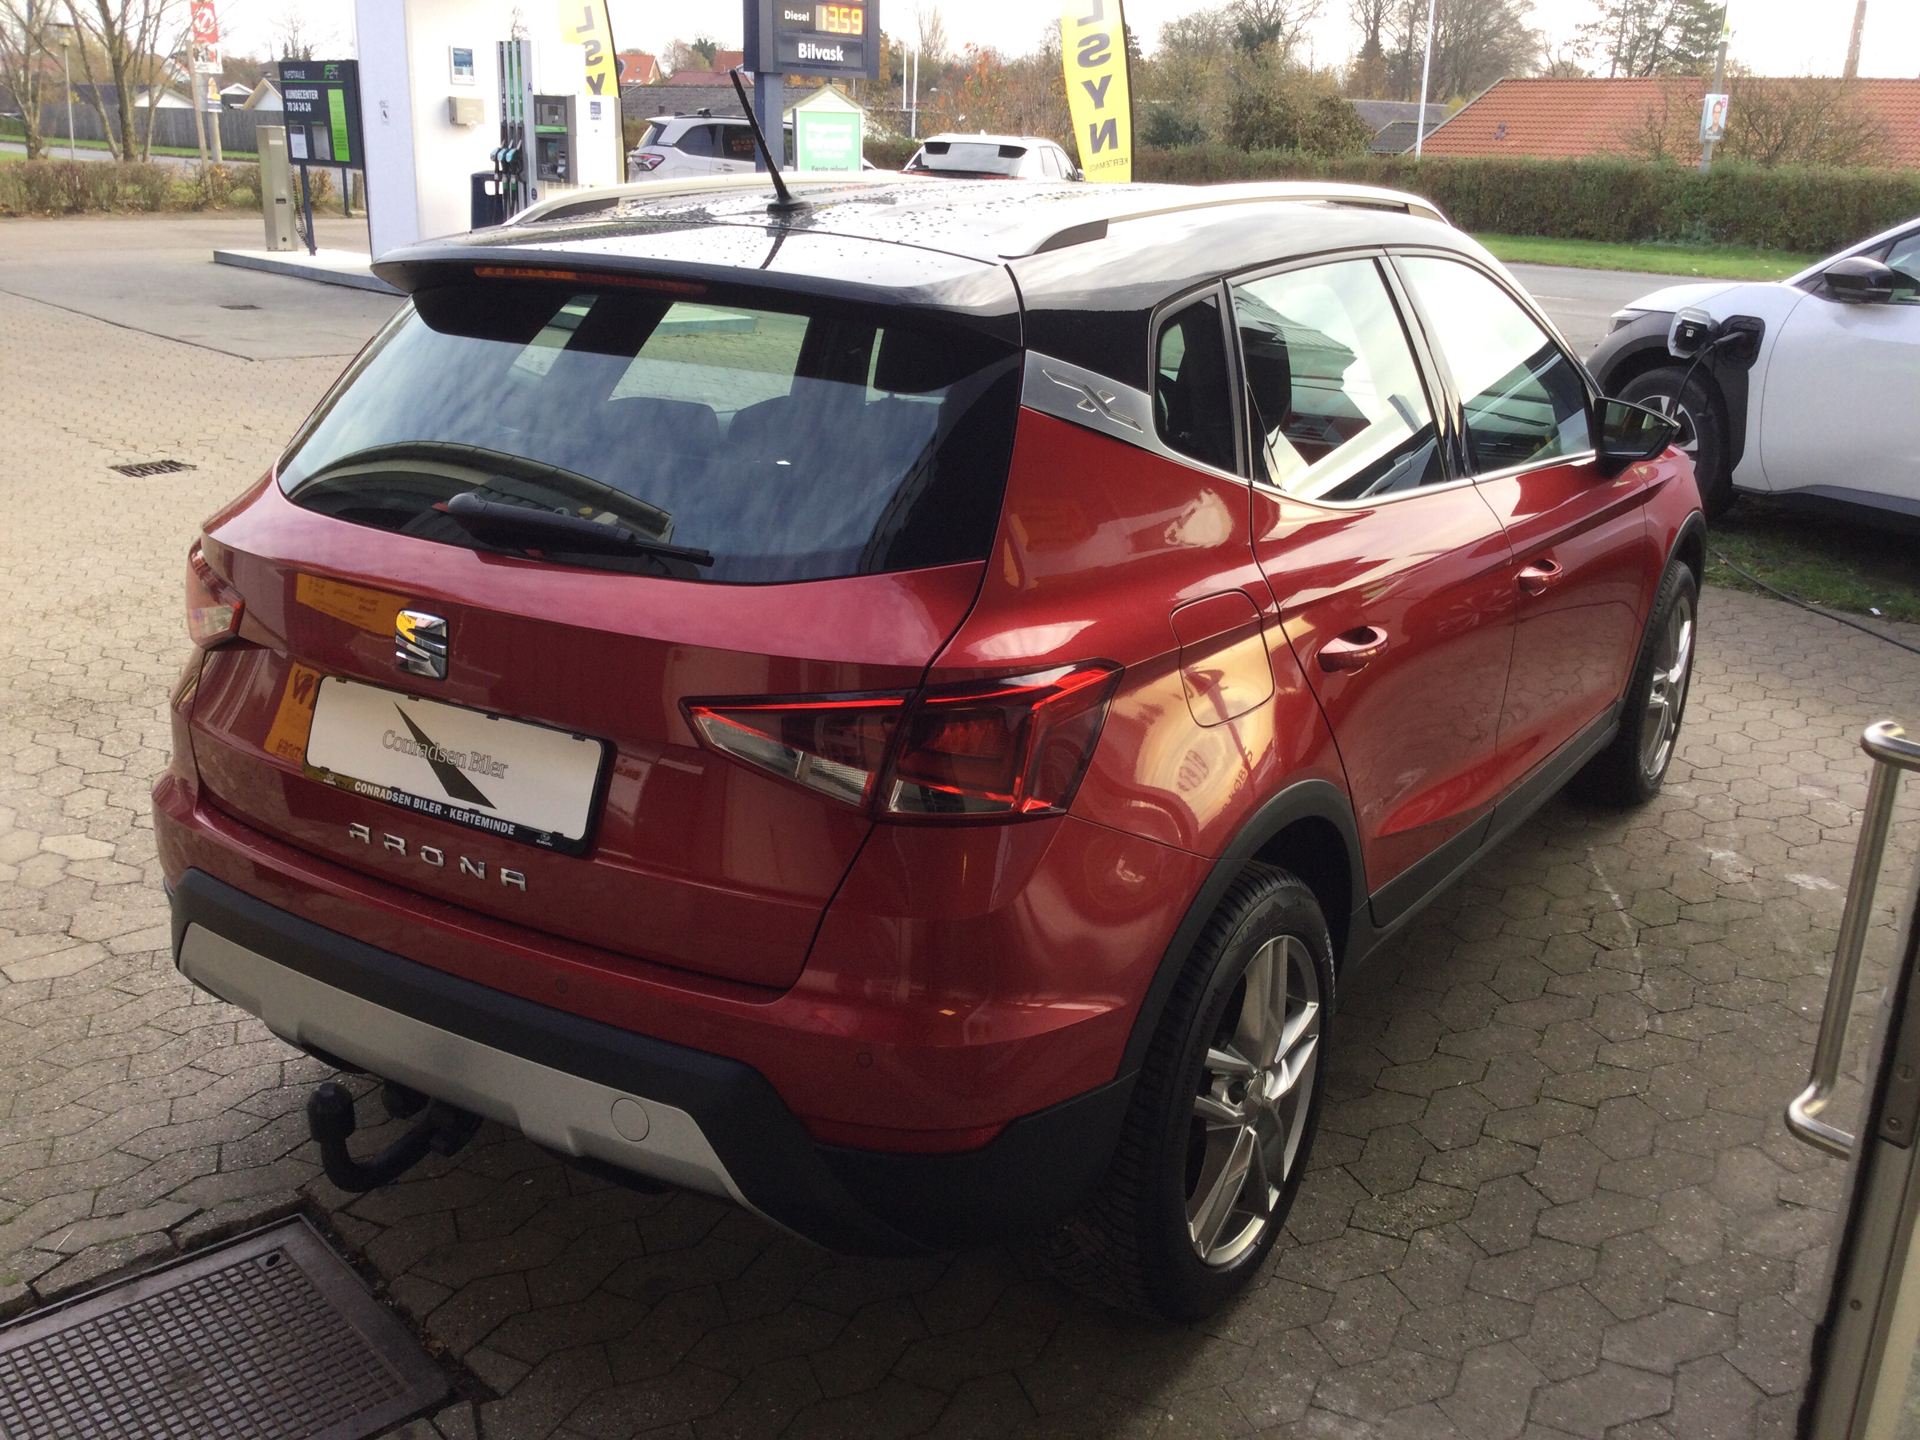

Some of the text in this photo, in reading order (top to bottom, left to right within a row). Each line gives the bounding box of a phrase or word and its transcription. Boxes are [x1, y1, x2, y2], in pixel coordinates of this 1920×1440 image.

[784, 10, 810, 22] Diesel
[798, 42, 844, 62] Bilvask
[285, 89, 319, 100] KUNDECENTER
[382, 729, 509, 780] Conradsen Biler
[354, 780, 412, 807] CONRADSEN
[413, 797, 442, 816] BILER
[449, 808, 516, 836] KERTEMINDE
[349, 822, 528, 892] ARONA
